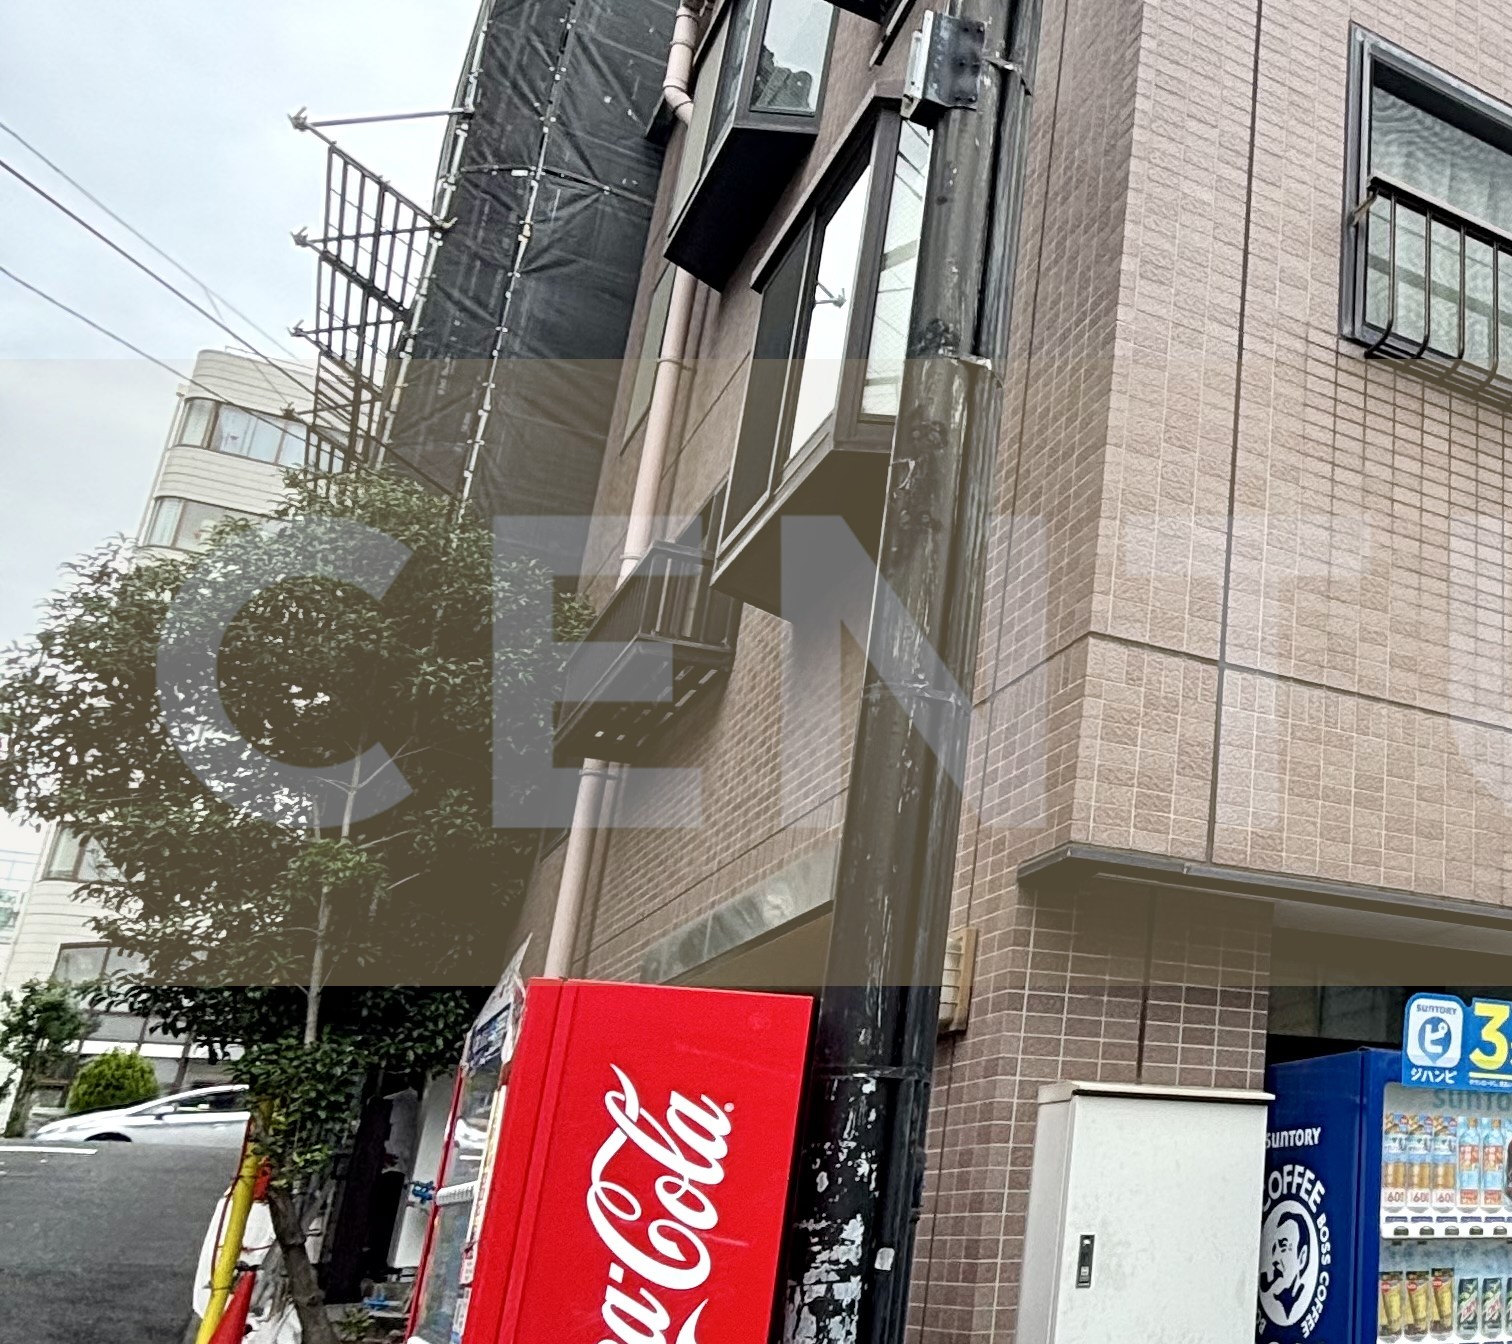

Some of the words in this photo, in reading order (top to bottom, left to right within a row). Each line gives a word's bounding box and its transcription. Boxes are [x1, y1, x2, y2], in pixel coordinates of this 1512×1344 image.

[1416, 1003, 1457, 1016] SUNTORY
[1410, 1067, 1458, 1084] ジハンピ
[1263, 1164, 1326, 1214] OFFEE
[1316, 1212, 1331, 1266] BOSS
[1300, 1271, 1330, 1339] COFFEE
